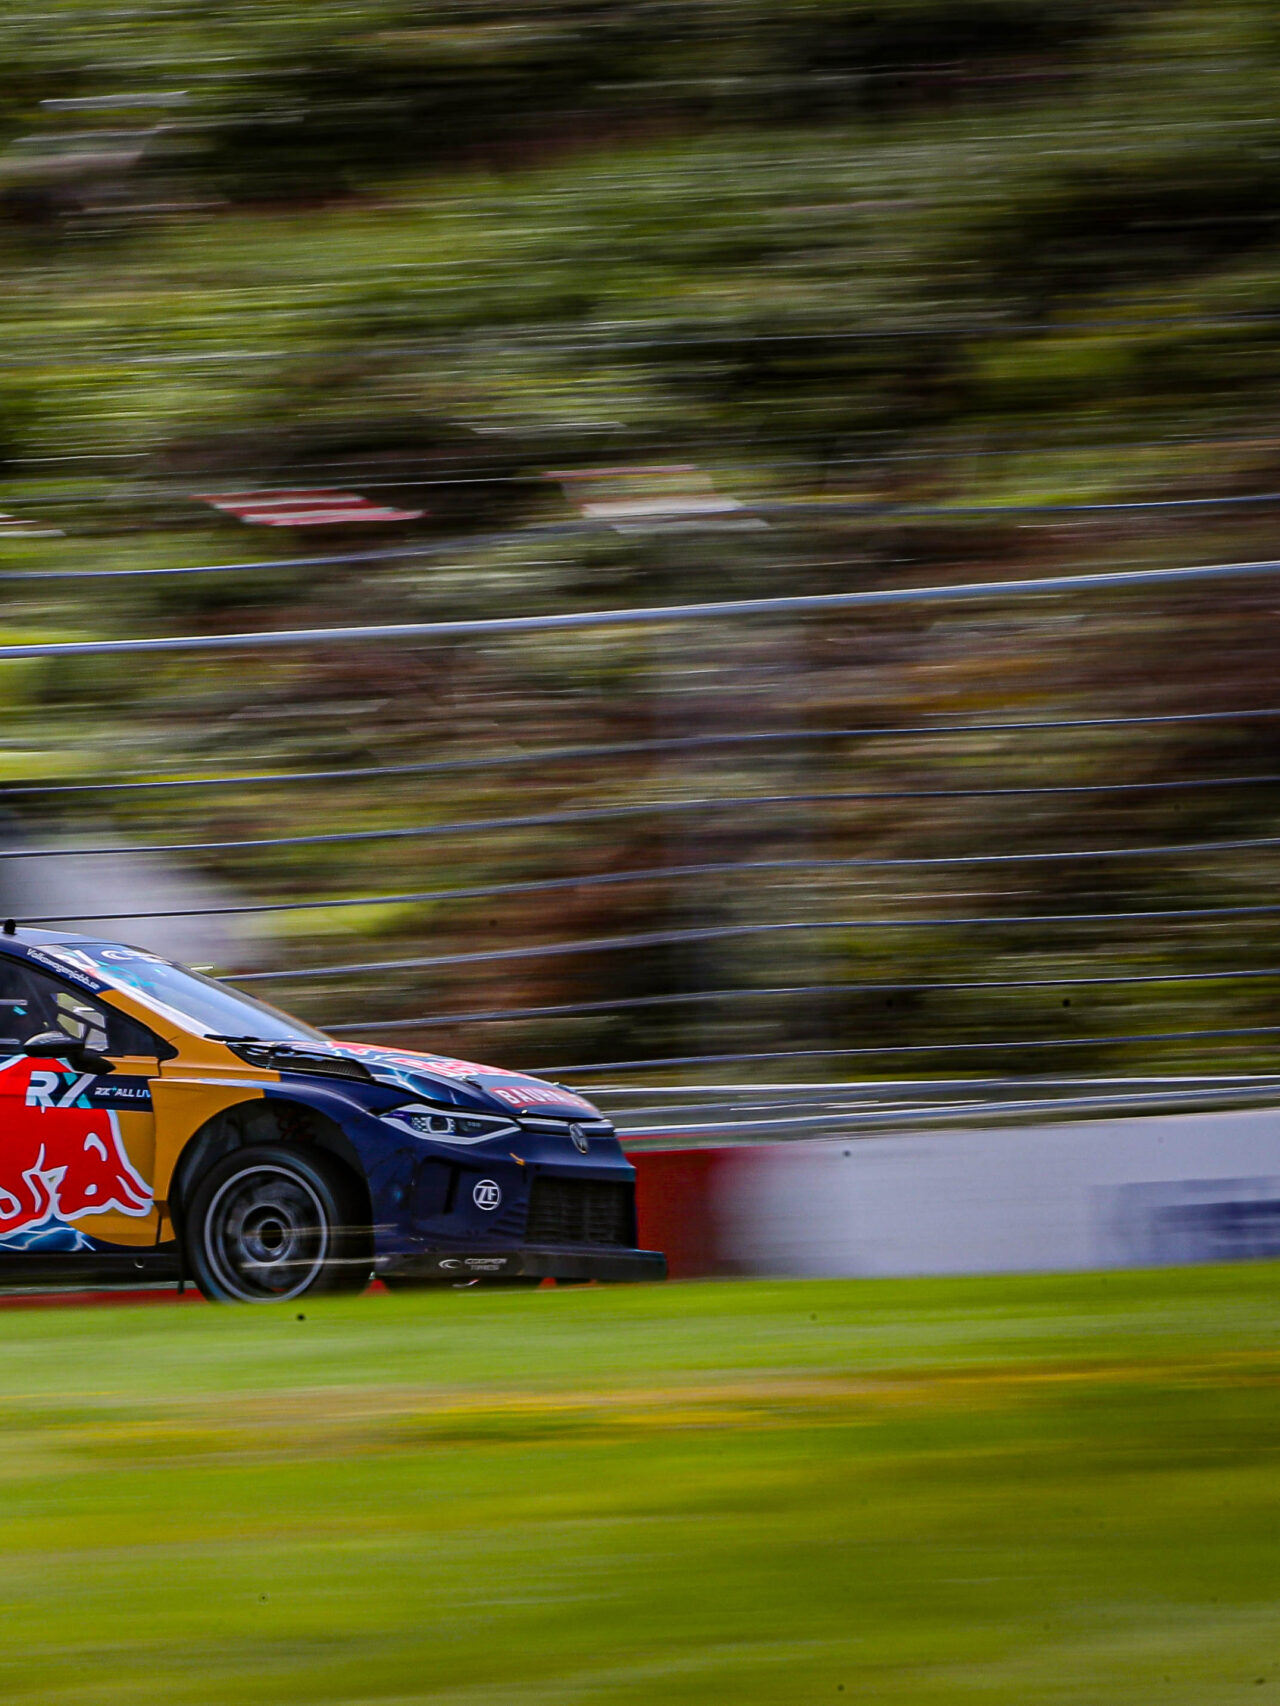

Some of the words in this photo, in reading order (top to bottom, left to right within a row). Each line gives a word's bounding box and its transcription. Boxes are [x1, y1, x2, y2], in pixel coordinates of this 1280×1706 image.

[25, 1070, 98, 1109] RX
[114, 1088, 135, 1098] ALL
[474, 1184, 499, 1206] ZF
